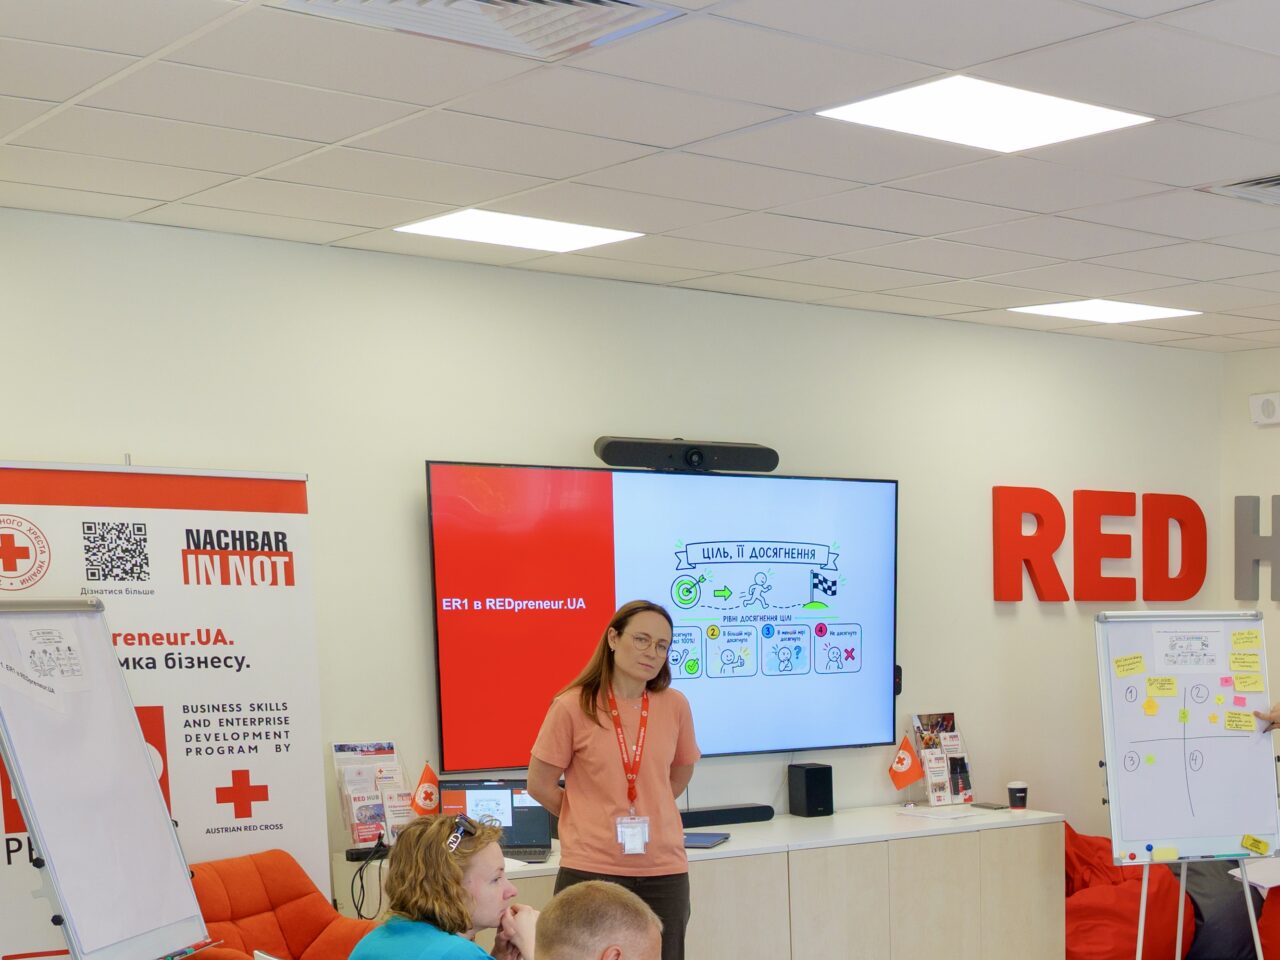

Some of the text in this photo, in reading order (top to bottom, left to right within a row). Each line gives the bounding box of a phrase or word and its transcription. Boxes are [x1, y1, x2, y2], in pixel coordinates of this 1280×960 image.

[26, 526, 46, 555] ХРЕСТА
[185, 529, 288, 552] NACHBAR
[992, 486, 1208, 602] RED
[702, 544, 816, 560] ЦІЛЬ, ЇЇ ДОСЯГНЕННЯ
[20, 560, 46, 586] УКРАЇНИ
[187, 554, 289, 587] IN NOT
[80, 587, 155, 596] Дізнатися більше
[442, 597, 586, 613] ER1 в REDpreneur.UA
[164, 652, 251, 673] бізнесу.
[182, 702, 288, 714] BUSINESS SKILLS
[183, 716, 290, 729] AND ENTERPRISE
[184, 730, 290, 743] DEVELOPMENT
[186, 743, 291, 757] PROGRAM BY
[205, 826, 243, 834] AUSTRIAN
[259, 823, 284, 831] CROSS
